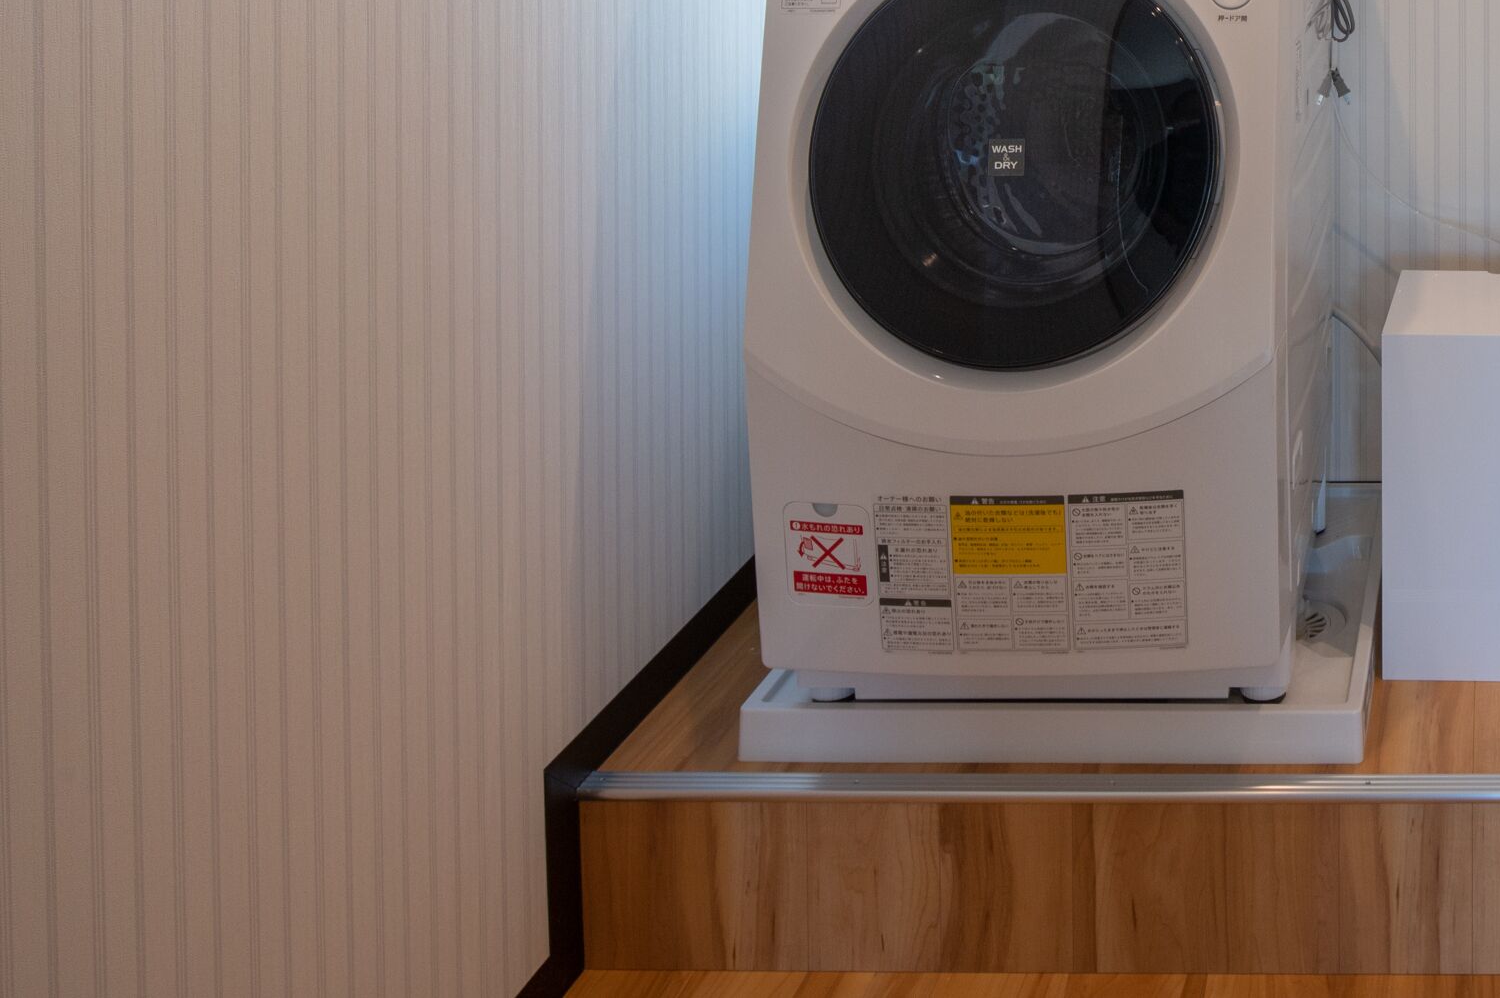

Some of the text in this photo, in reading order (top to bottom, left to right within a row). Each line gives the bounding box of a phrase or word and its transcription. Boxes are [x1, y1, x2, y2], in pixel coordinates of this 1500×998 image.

[991, 145, 1022, 154] WASH
[994, 161, 1018, 170] DRY
[877, 495, 942, 503] オーナー様へのお願い
[801, 522, 861, 534] 水もれの恐れあり
[802, 574, 858, 584] 運転中は、ふたを
[796, 583, 865, 594] 開けないでください。
